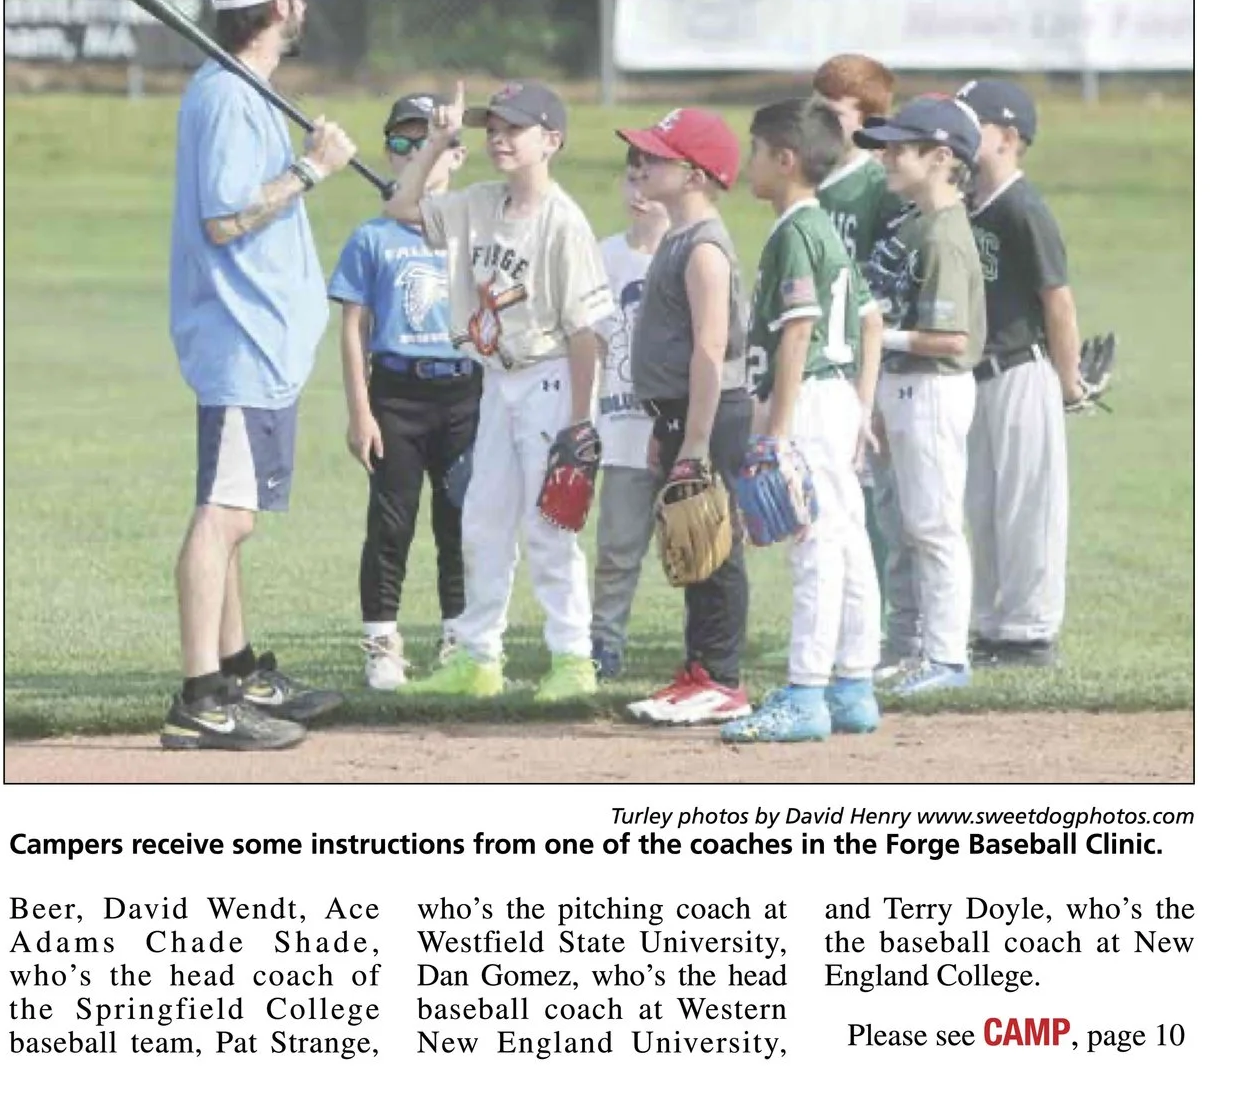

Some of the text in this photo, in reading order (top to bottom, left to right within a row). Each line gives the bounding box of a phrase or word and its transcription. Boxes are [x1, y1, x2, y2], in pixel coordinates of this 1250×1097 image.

[611, 806, 1195, 830] Turley photos by David Henry www.sweetdogphotos.com
[9, 831, 1163, 861] Campers receive some instructions from one of the coaches in the Forge Baseball Clinic.
[9, 896, 380, 924] Beer, David Wendt, Ace
[416, 929, 787, 960] Westfield State University,
[824, 963, 1040, 993] England College.
[847, 1017, 1185, 1053] Please see CAMP, page 10
